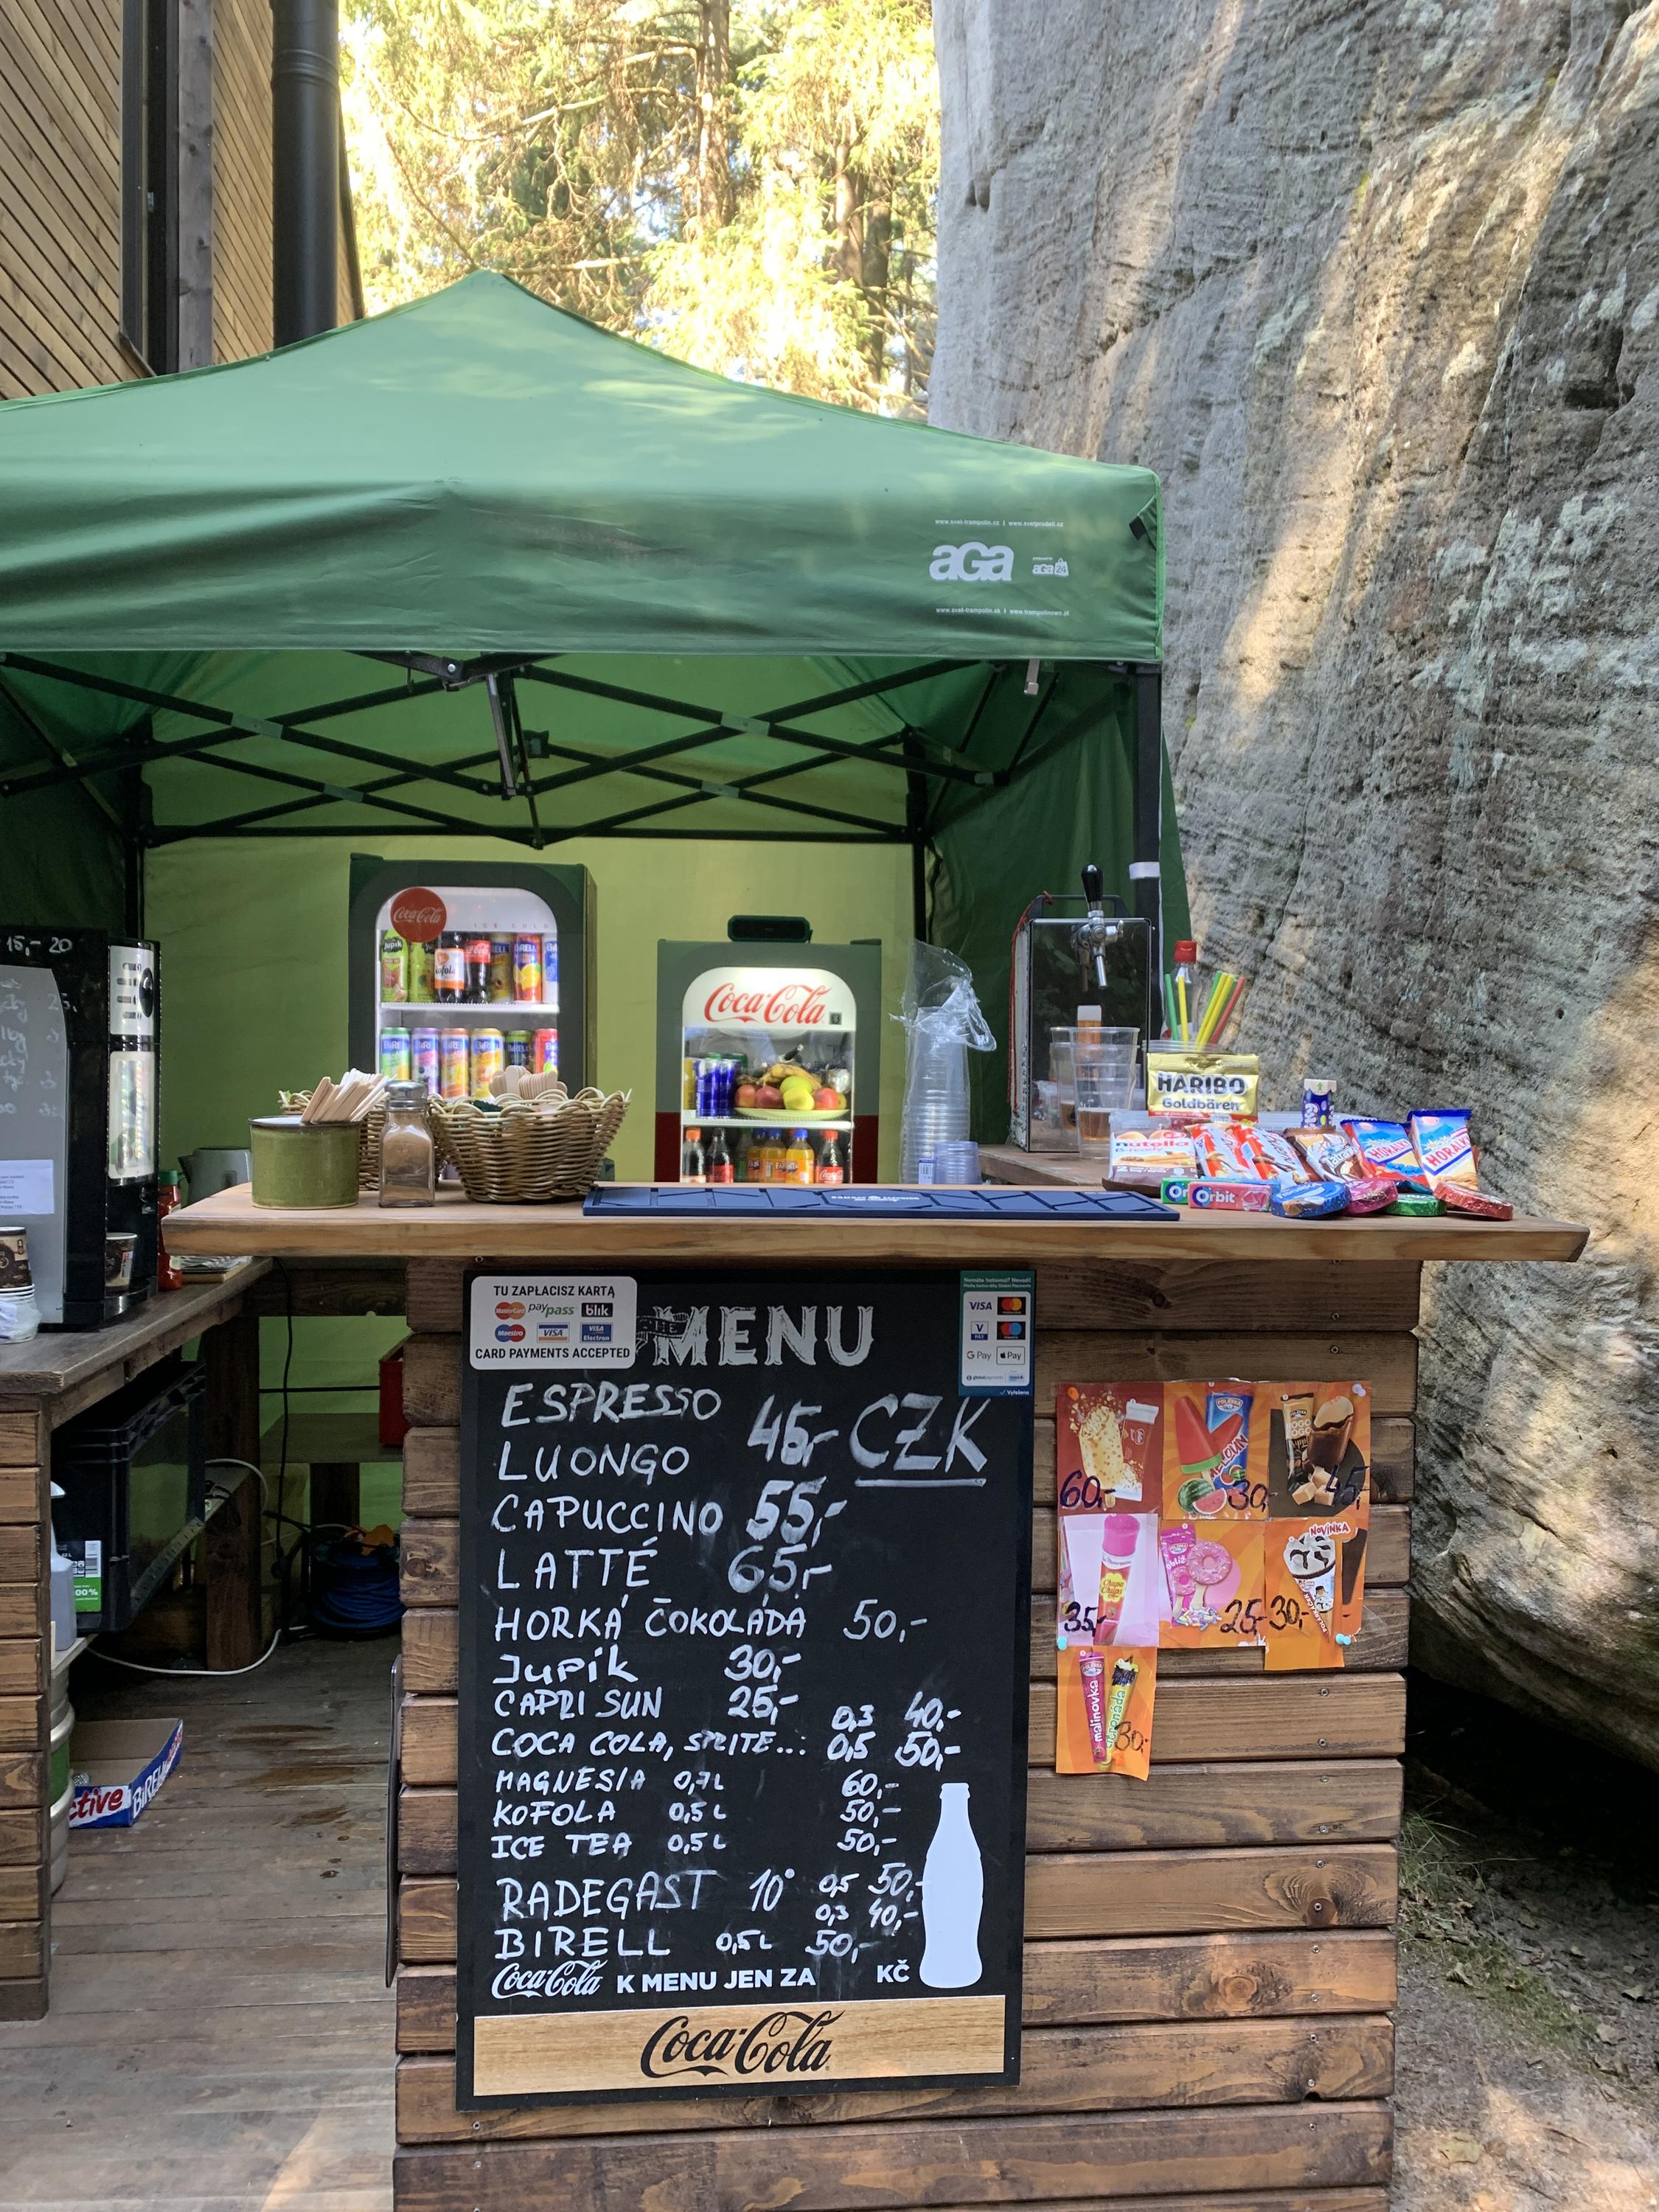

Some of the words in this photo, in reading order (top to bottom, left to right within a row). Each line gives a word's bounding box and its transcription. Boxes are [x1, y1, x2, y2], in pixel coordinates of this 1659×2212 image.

[393, 906, 442, 924] Coca-Cola
[49, 936, 73, 953] 20
[704, 983, 833, 1024] Coca-Cola
[1157, 1074, 1246, 1095] HARIBO
[1163, 1096, 1240, 1111] Goldbären
[1196, 1190, 1235, 1205] Orbit
[493, 1286, 509, 1296] TU
[512, 1286, 575, 1296] ZAPŁACISZ
[578, 1285, 615, 1298] KARTĄ
[969, 1301, 992, 1310] VISA
[495, 1307, 526, 1315] MasterCard
[585, 1303, 609, 1316] blik
[543, 1329, 563, 1337] VISA
[653, 1306, 874, 1366] MENU
[475, 1349, 506, 1359] CARD
[509, 1348, 569, 1359] PAYMENTS
[572, 1348, 630, 1358] ACCEPTED
[977, 1351, 992, 1362] Pay
[1007, 1352, 1022, 1361] Pay
[501, 1380, 722, 1427] ESPRESSO
[849, 1393, 991, 1473] CZK
[498, 1441, 690, 1486] LUONGO
[1060, 1470, 1116, 1509] 60,-
[490, 1493, 723, 1536] CAPUCCINO
[498, 1536, 658, 1590] LATTÉ
[75, 1588, 99, 1596] 00%
[1101, 1586, 1123, 1596] Chups
[1103, 1579, 1124, 1588] Chupa
[495, 1593, 629, 1641] HORKÁ
[844, 1599, 928, 1643] 50,-
[1269, 1595, 1310, 1631] 30,-
[724, 1644, 801, 1683] 30,-
[494, 1688, 585, 1720] CAPRI
[594, 1686, 663, 1719] SUN
[727, 1684, 799, 1725] 25,-
[832, 1704, 874, 1732] 0,3
[904, 1691, 961, 1732] 40,-
[1087, 1679, 1103, 1743] malinovka
[491, 1728, 575, 1758] COCA
[590, 1731, 673, 1761] COLA,
[827, 1731, 876, 1762] 0,5
[894, 1731, 961, 1771] 50,-
[495, 1766, 646, 1795] MAGNESIA
[842, 1769, 900, 1799] 60,-
[493, 1799, 616, 1827] KOFOLA
[840, 1799, 902, 1828] 50,-
[491, 1834, 545, 1860] ICE
[566, 1832, 633, 1860] TEA
[837, 1828, 897, 1856] 50,-
[496, 1870, 720, 1921] RADEGAST
[818, 1874, 860, 1898] 0,5
[815, 1903, 849, 1927] 0,3
[494, 1926, 671, 1960] BIRELL
[491, 1960, 608, 2000] Coca-Cola
[616, 1975, 635, 1993] K
[641, 1972, 717, 1992] MENU
[724, 1969, 773, 1989] JEN
[780, 1968, 816, 1986] ZA
[877, 1959, 910, 1983] KČ
[641, 2010, 846, 2079] Coca-Cola
